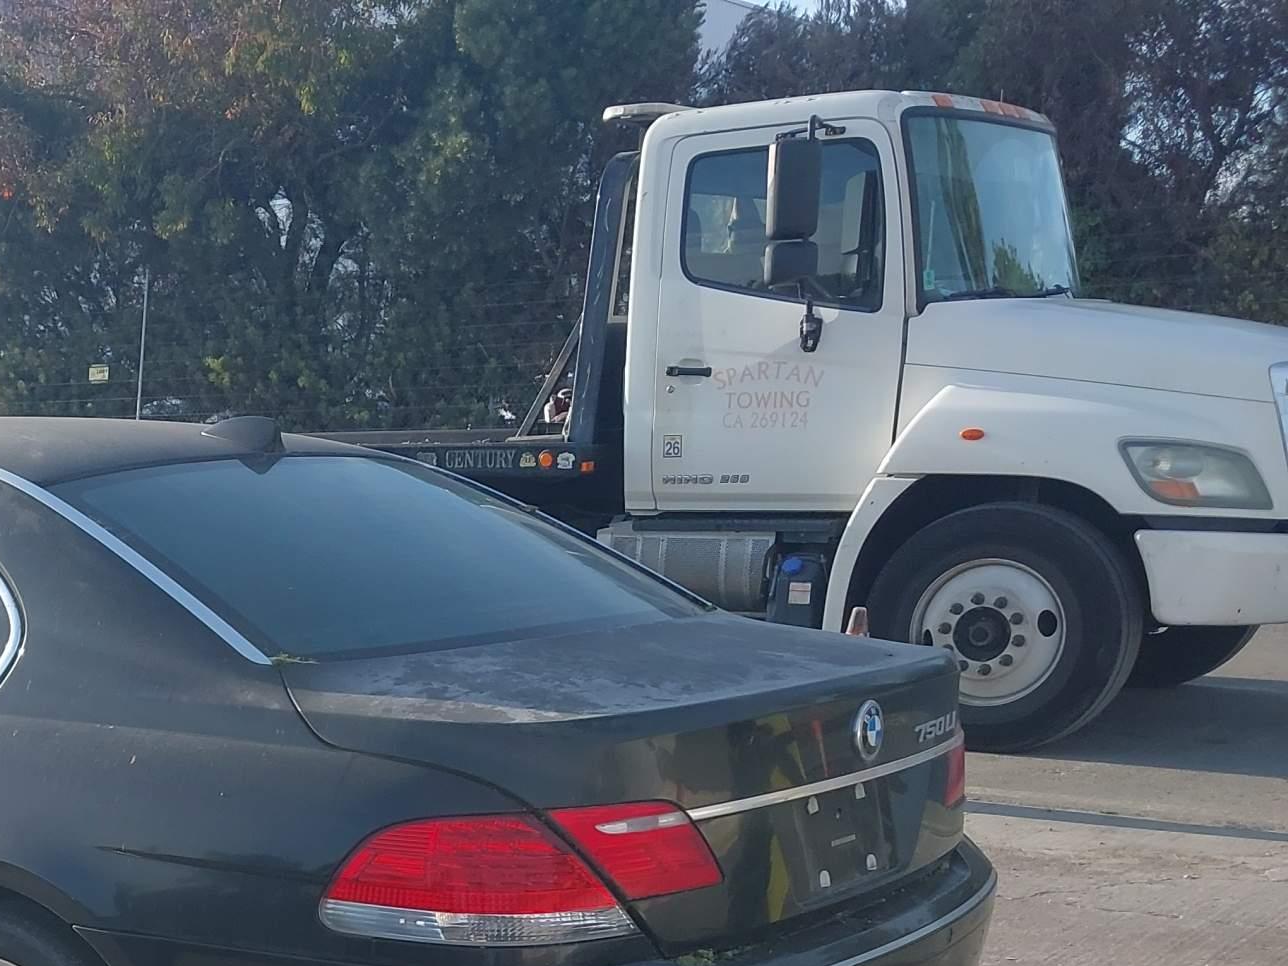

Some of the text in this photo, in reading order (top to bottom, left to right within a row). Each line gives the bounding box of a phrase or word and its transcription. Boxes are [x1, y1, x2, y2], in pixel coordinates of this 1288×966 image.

[713, 360, 825, 390] SPARTAN
[725, 390, 811, 409] TOWING
[722, 411, 809, 429] CA 269124
[665, 440, 681, 456] 26
[445, 449, 516, 469] CENTURY
